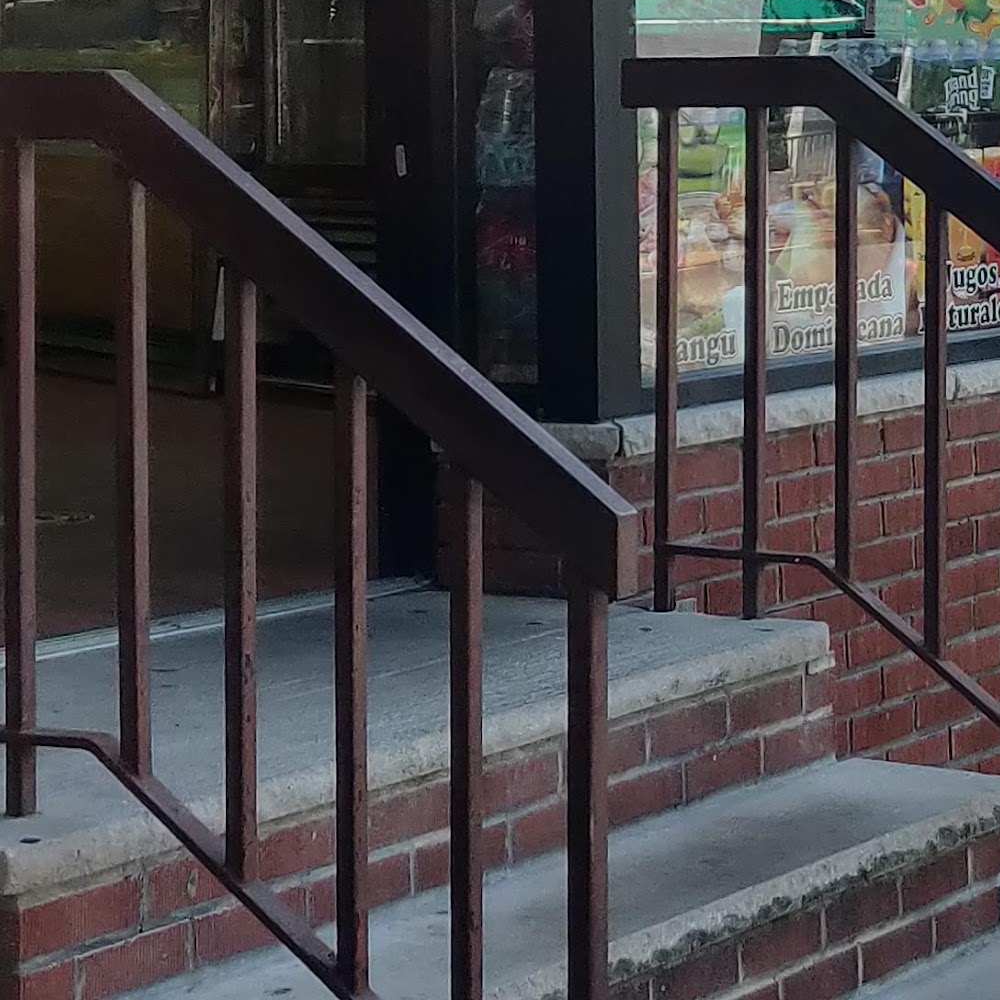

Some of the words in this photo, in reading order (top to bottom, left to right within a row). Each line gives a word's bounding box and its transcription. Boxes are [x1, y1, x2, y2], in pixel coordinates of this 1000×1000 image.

[777, 271, 893, 313] Empaada
[676, 330, 736, 365] angu
[772, 314, 905, 354] Domicana
